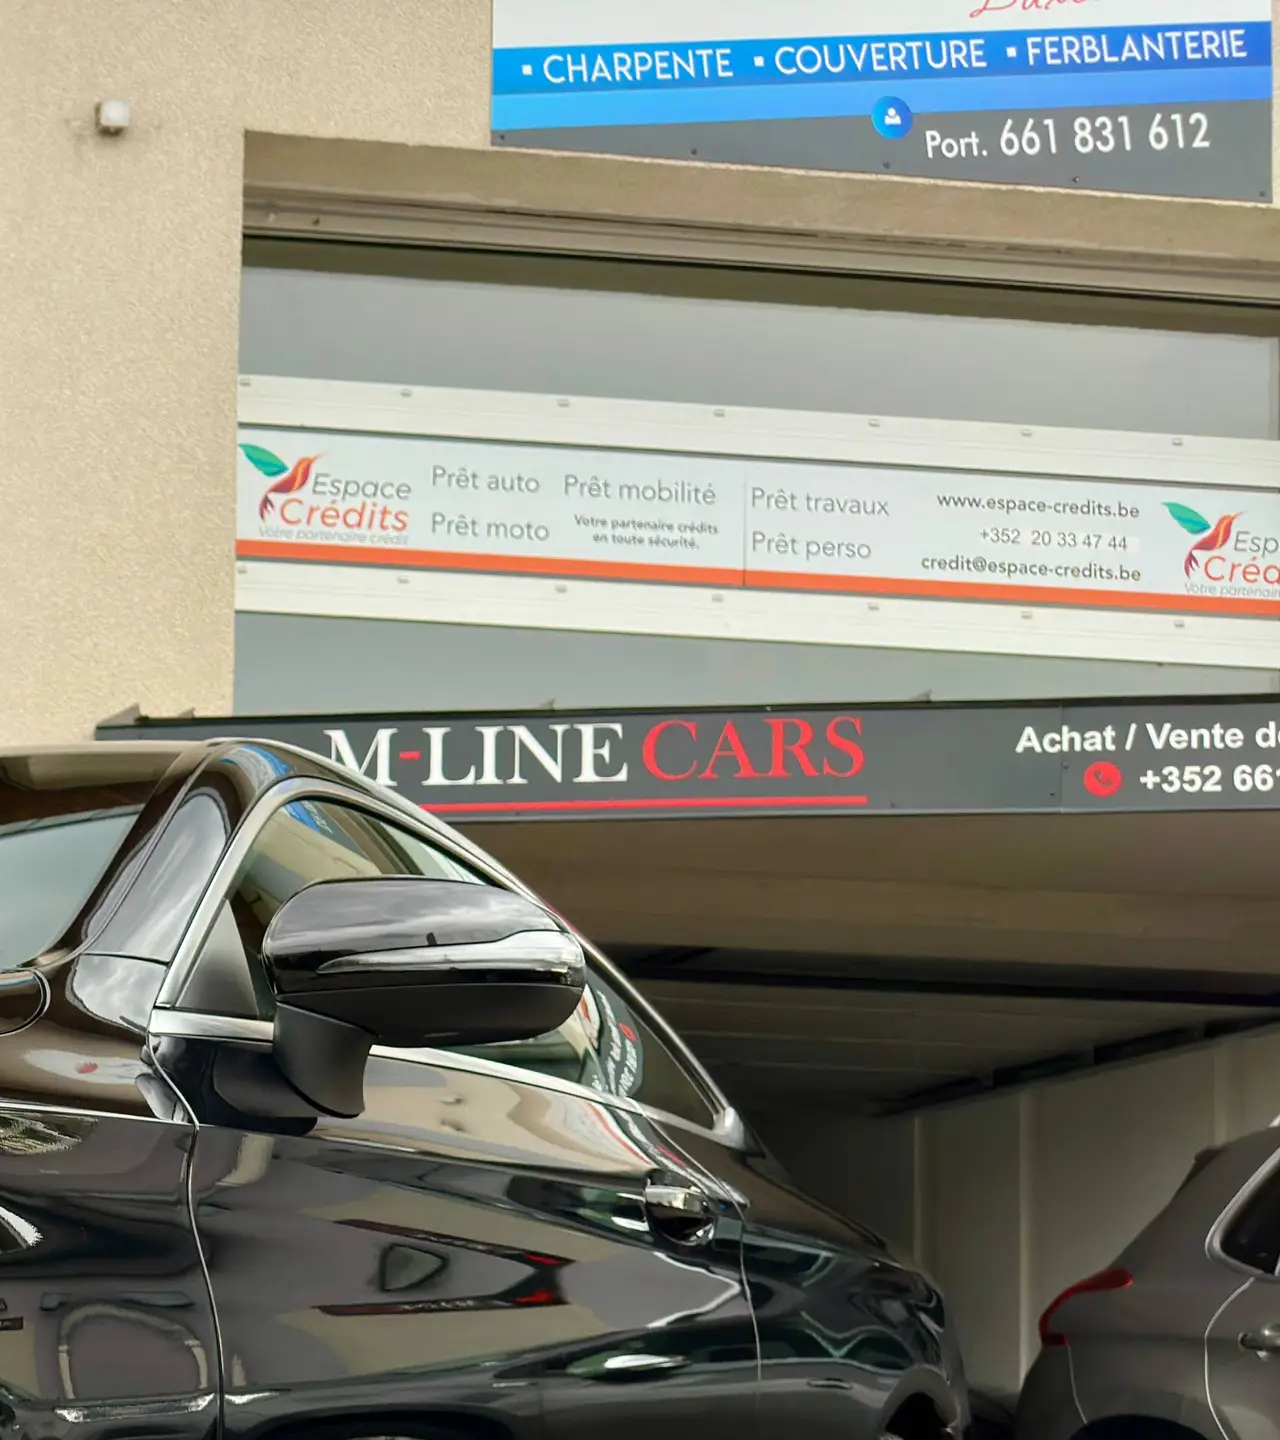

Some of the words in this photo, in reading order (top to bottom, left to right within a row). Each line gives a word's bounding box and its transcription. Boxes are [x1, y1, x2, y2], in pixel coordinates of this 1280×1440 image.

[543, 49, 734, 84] CHARPENTE
[775, 38, 987, 76] COUVERTURE
[1026, 28, 1247, 66] FERBLANTERIE
[926, 129, 988, 161] Port.
[1000, 118, 1057, 157] 661
[1073, 115, 1132, 152] 831
[1149, 112, 1210, 150] 612
[311, 472, 412, 501] Espace
[431, 465, 479, 493] Prêt
[487, 470, 540, 494] auto
[564, 474, 613, 500] Prêt
[617, 478, 717, 506] mobilité
[279, 498, 410, 533] Crédits
[750, 486, 799, 512] Prêt
[805, 491, 890, 517] travaux
[936, 494, 1140, 519] www.espace-credits.be
[431, 512, 479, 537] Prêt
[486, 518, 550, 543] moto
[573, 513, 608, 528] Votre
[610, 517, 675, 532] partenaire
[592, 533, 608, 544] en
[611, 533, 645, 545] toute
[751, 531, 799, 557] Prêt
[804, 539, 872, 563] perso
[979, 527, 1021, 545] +352
[1030, 529, 1052, 547] 20
[1056, 531, 1078, 548] 33
[1082, 533, 1102, 549] 47
[1107, 535, 1128, 552] 44
[921, 554, 1142, 582] credit@espace-credits.be
[322, 720, 629, 788] M-LINE
[641, 715, 866, 782] CARS
[1015, 723, 1117, 754] Achat
[1145, 721, 1245, 750] Vente
[1140, 764, 1223, 794] +352
